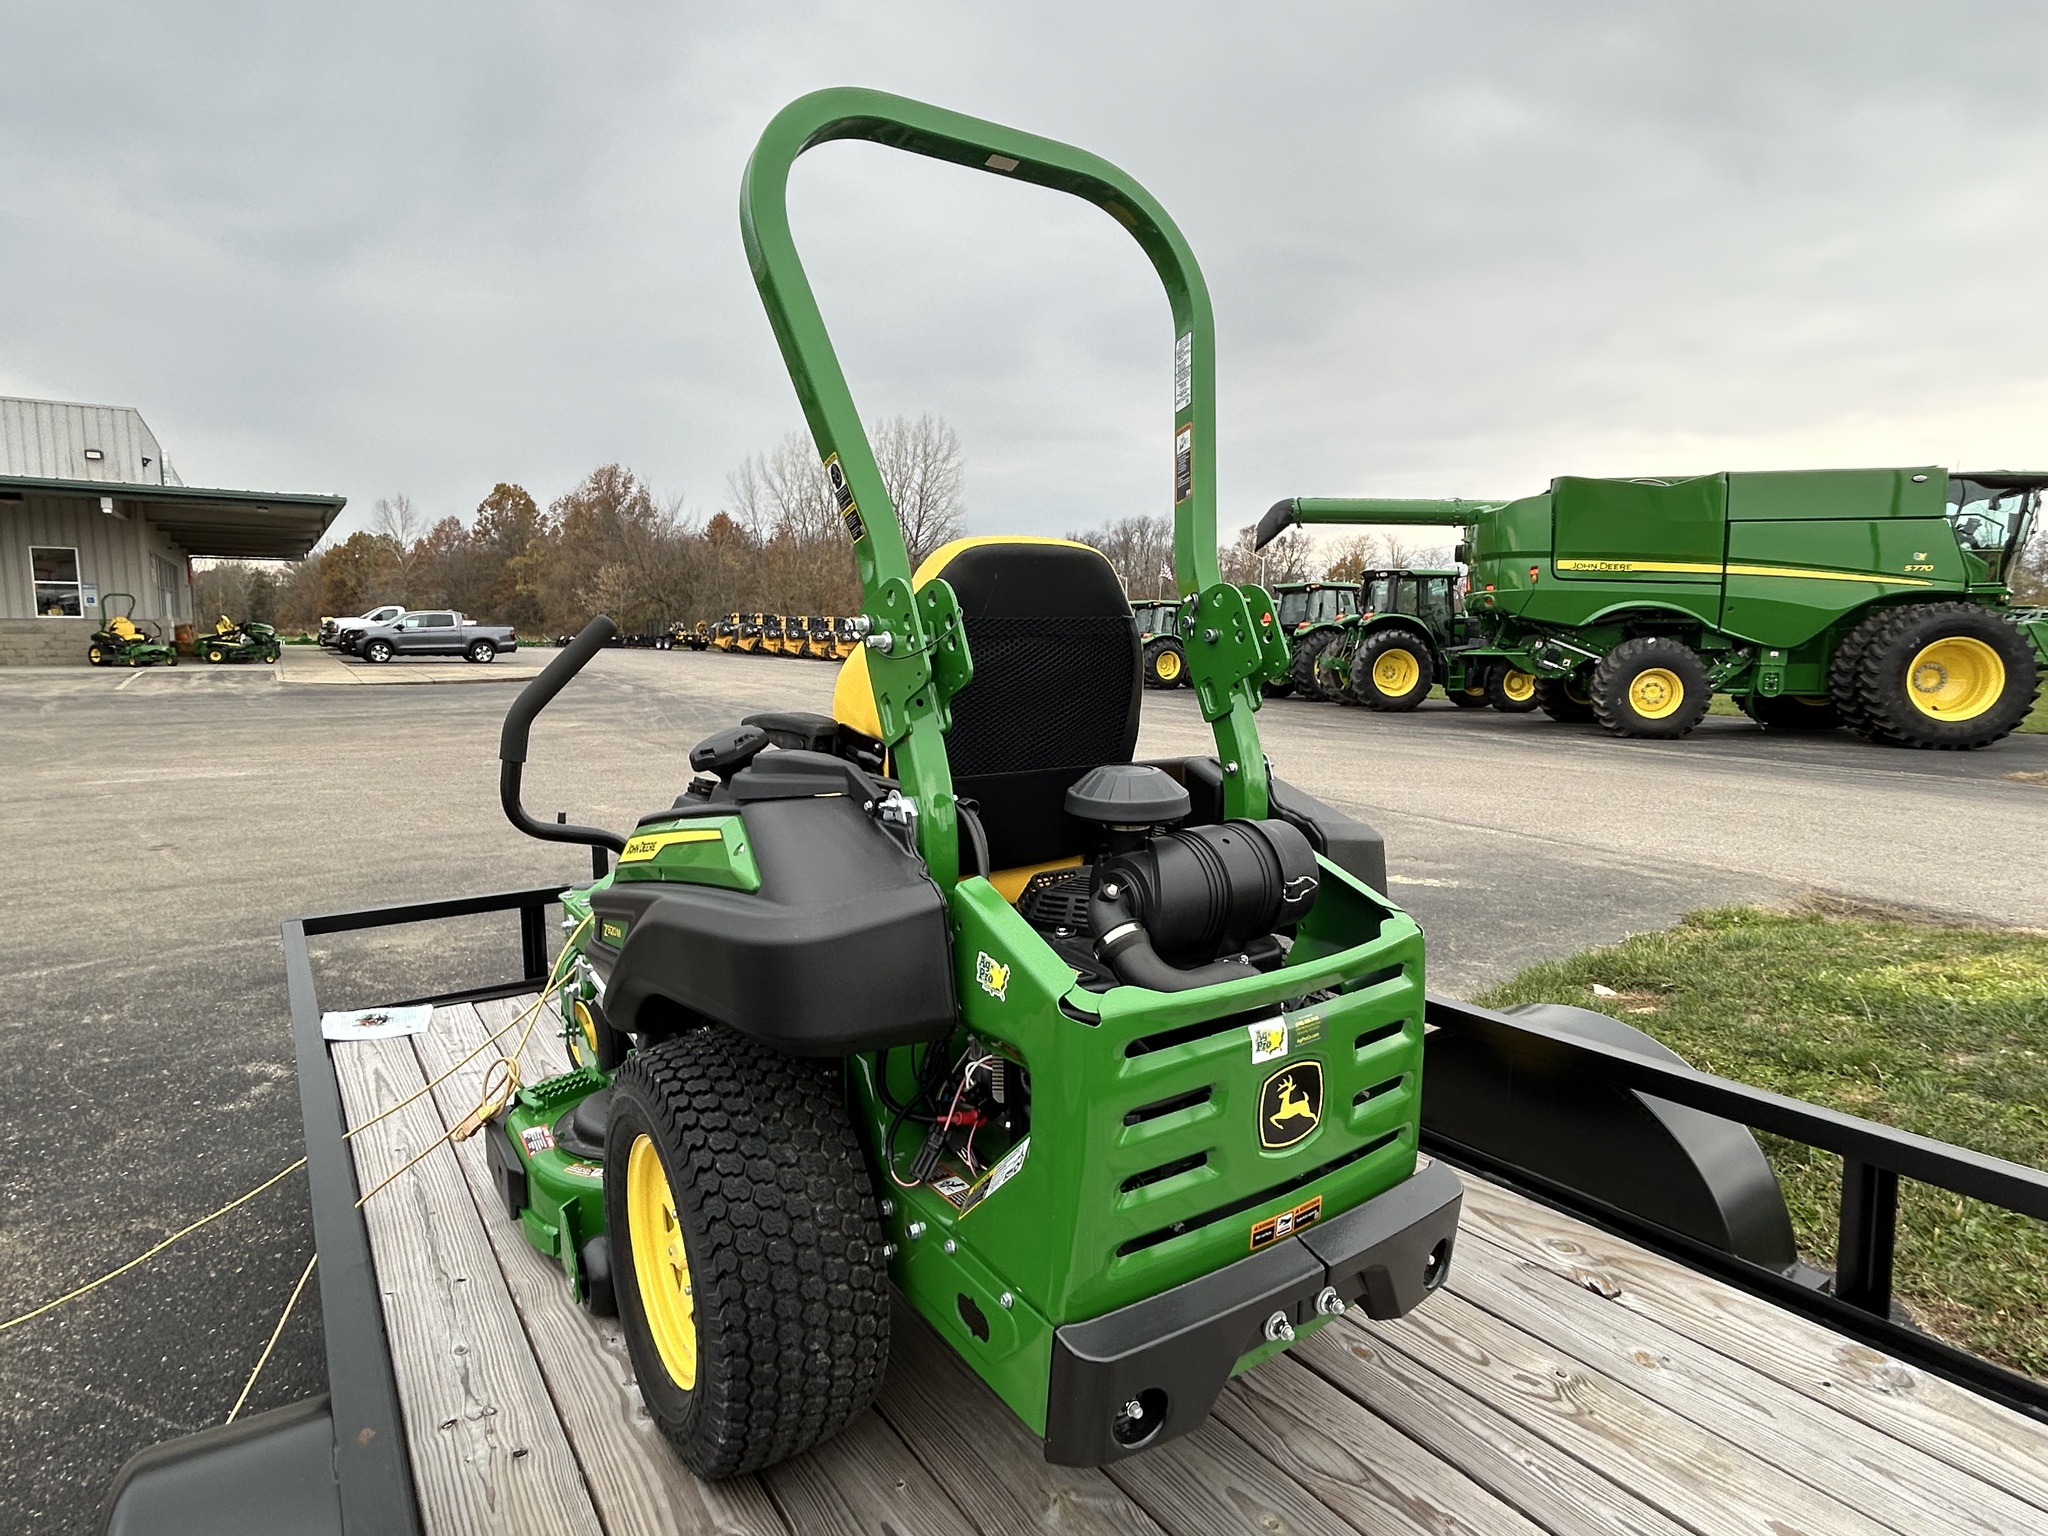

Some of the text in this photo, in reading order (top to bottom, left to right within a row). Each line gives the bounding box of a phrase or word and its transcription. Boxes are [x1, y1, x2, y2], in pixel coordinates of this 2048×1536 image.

[1572, 562, 1632, 570] JOHN DEERE
[1904, 564, 1934, 572] S770
[626, 841, 657, 855] JOHN DEERE
[979, 967, 994, 984] Pro
[1255, 1041, 1272, 1053] Pro
